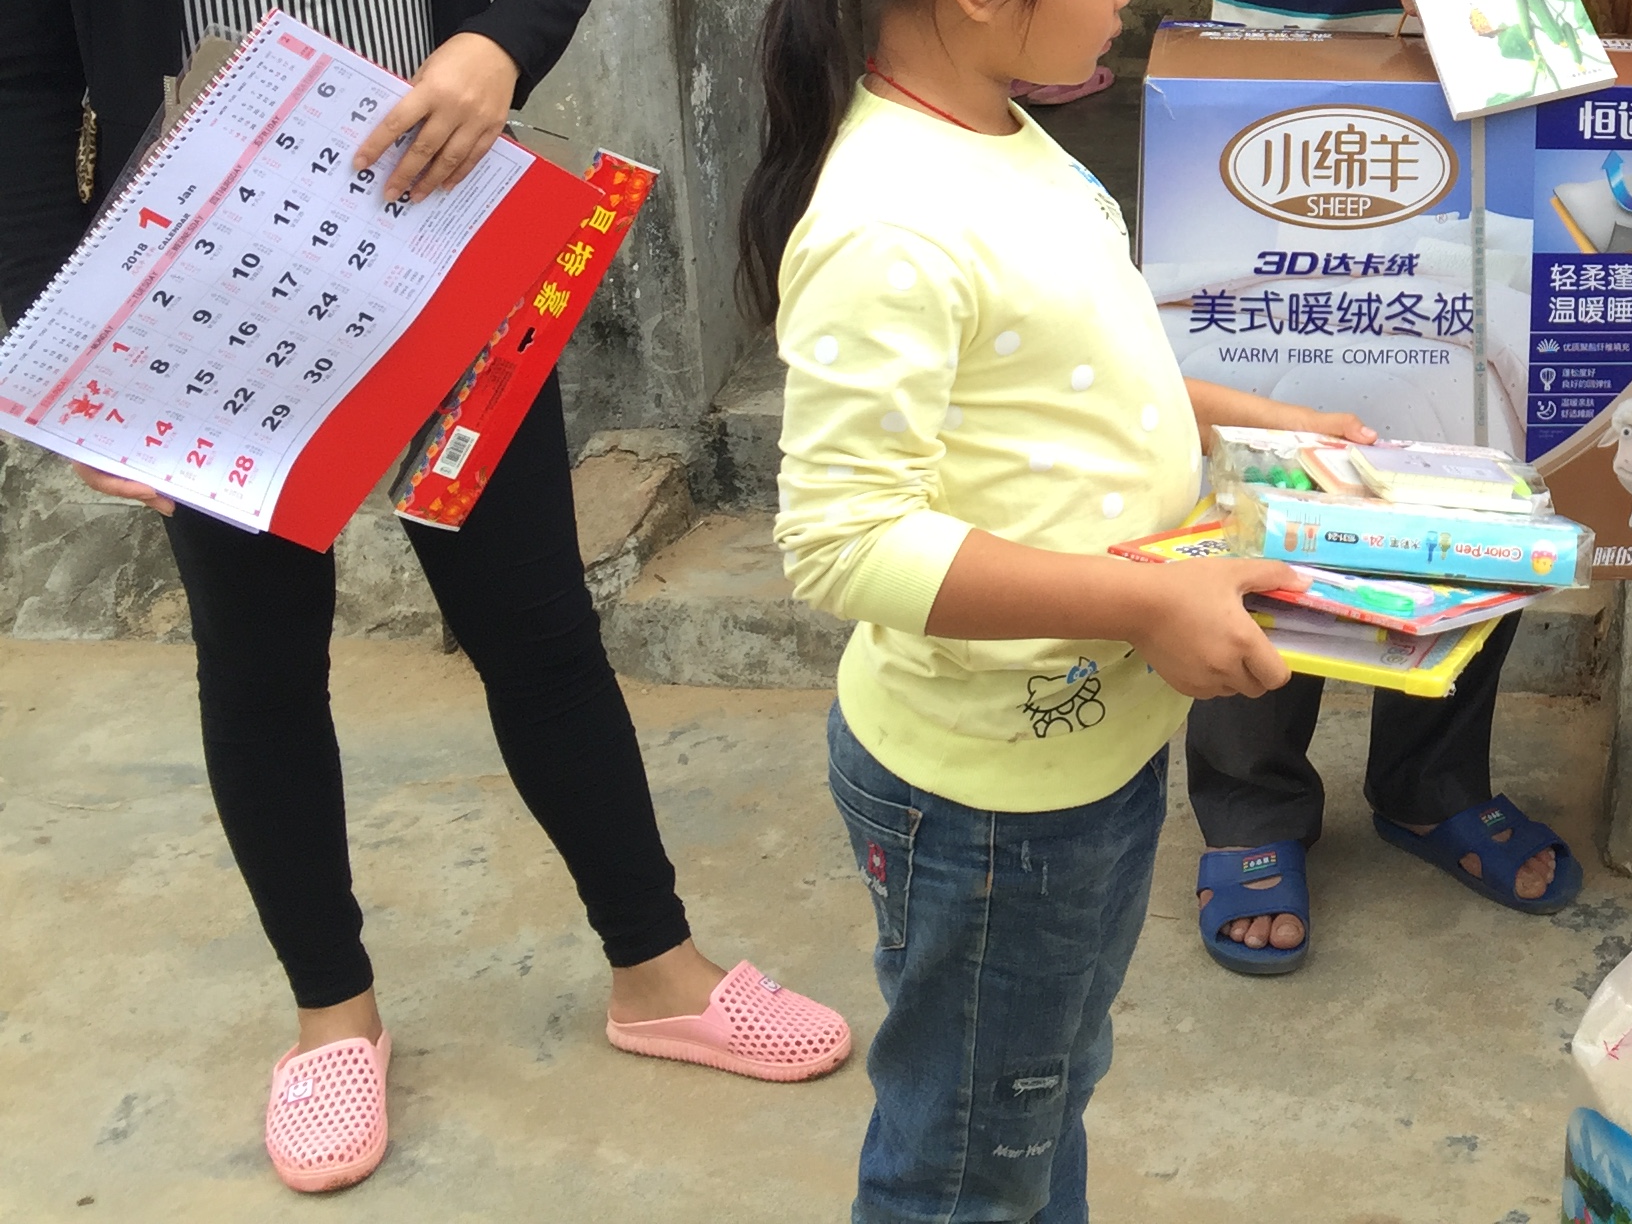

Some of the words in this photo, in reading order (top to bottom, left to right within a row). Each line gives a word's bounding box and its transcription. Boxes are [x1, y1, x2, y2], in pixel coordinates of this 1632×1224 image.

[317, 82, 336, 98] 6
[351, 97, 378, 122] 13
[275, 133, 295, 150] 5
[311, 147, 340, 174] 12
[349, 168, 375, 194] 19
[384, 190, 411, 219] 26
[1261, 123, 1419, 195] 小绵羊
[177, 185, 197, 205] Jan
[1306, 196, 1371, 217] SHEEP
[139, 207, 173, 229] 1
[239, 186, 256, 203] 4
[273, 199, 300, 226] 11
[312, 220, 338, 247] 18
[348, 239, 376, 271] 25
[121, 243, 148, 271] 2018
[1254, 251, 1420, 277] 3D达卡绒
[194, 238, 215, 255] 3
[232, 253, 260, 278] 10
[271, 271, 297, 298] 17
[308, 291, 338, 321] 24
[345, 311, 375, 338] 31
[1189, 289, 1474, 336] 美式暖绒冬被
[152, 290, 175, 307] 2
[192, 309, 212, 324] 9
[228, 321, 257, 346] 16
[265, 340, 296, 368] 23
[303, 357, 333, 384] 30
[1219, 347, 1278, 363] WARM
[1287, 348, 1334, 364] FIBRE
[1342, 349, 1450, 365] COMFORTER
[112, 342, 130, 353] 1
[149, 359, 170, 374] 8
[186, 369, 214, 394] 15
[223, 387, 255, 415] 22
[261, 404, 291, 432] 29
[105, 408, 125, 424] 7
[145, 420, 174, 447] 14
[186, 437, 214, 468] 21
[228, 455, 254, 488] 28
[1455, 543, 1482, 557] Pen
[1484, 547, 1522, 561] Color
